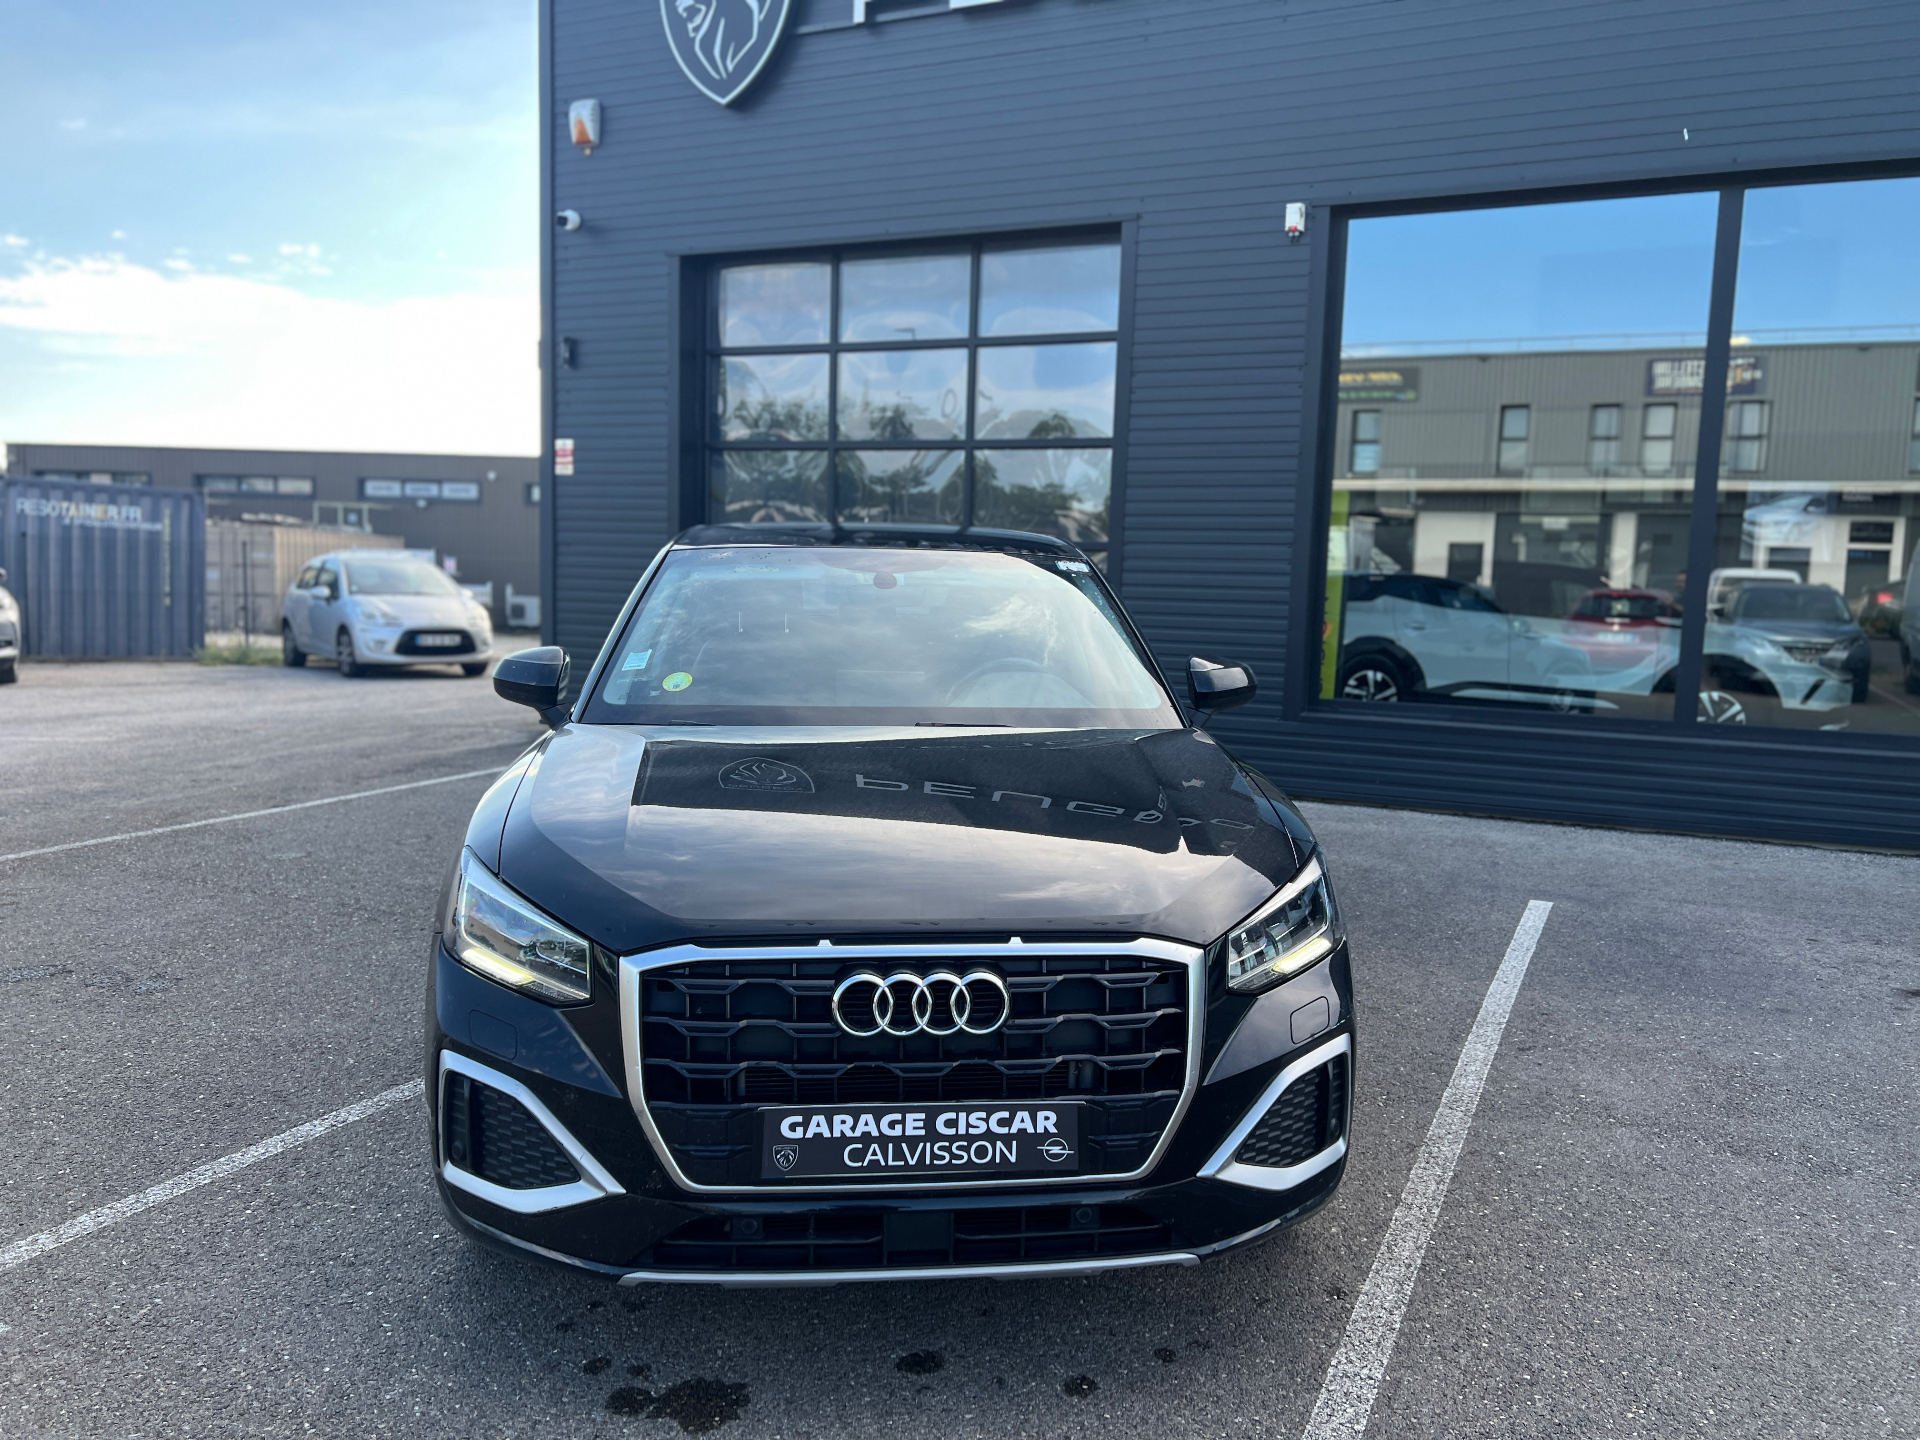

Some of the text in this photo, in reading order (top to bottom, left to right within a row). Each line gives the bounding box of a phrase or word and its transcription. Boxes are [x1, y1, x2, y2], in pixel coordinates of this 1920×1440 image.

[780, 1111, 1058, 1138] GARAGE CISCAR
[843, 1140, 1017, 1167] CALVISSON
